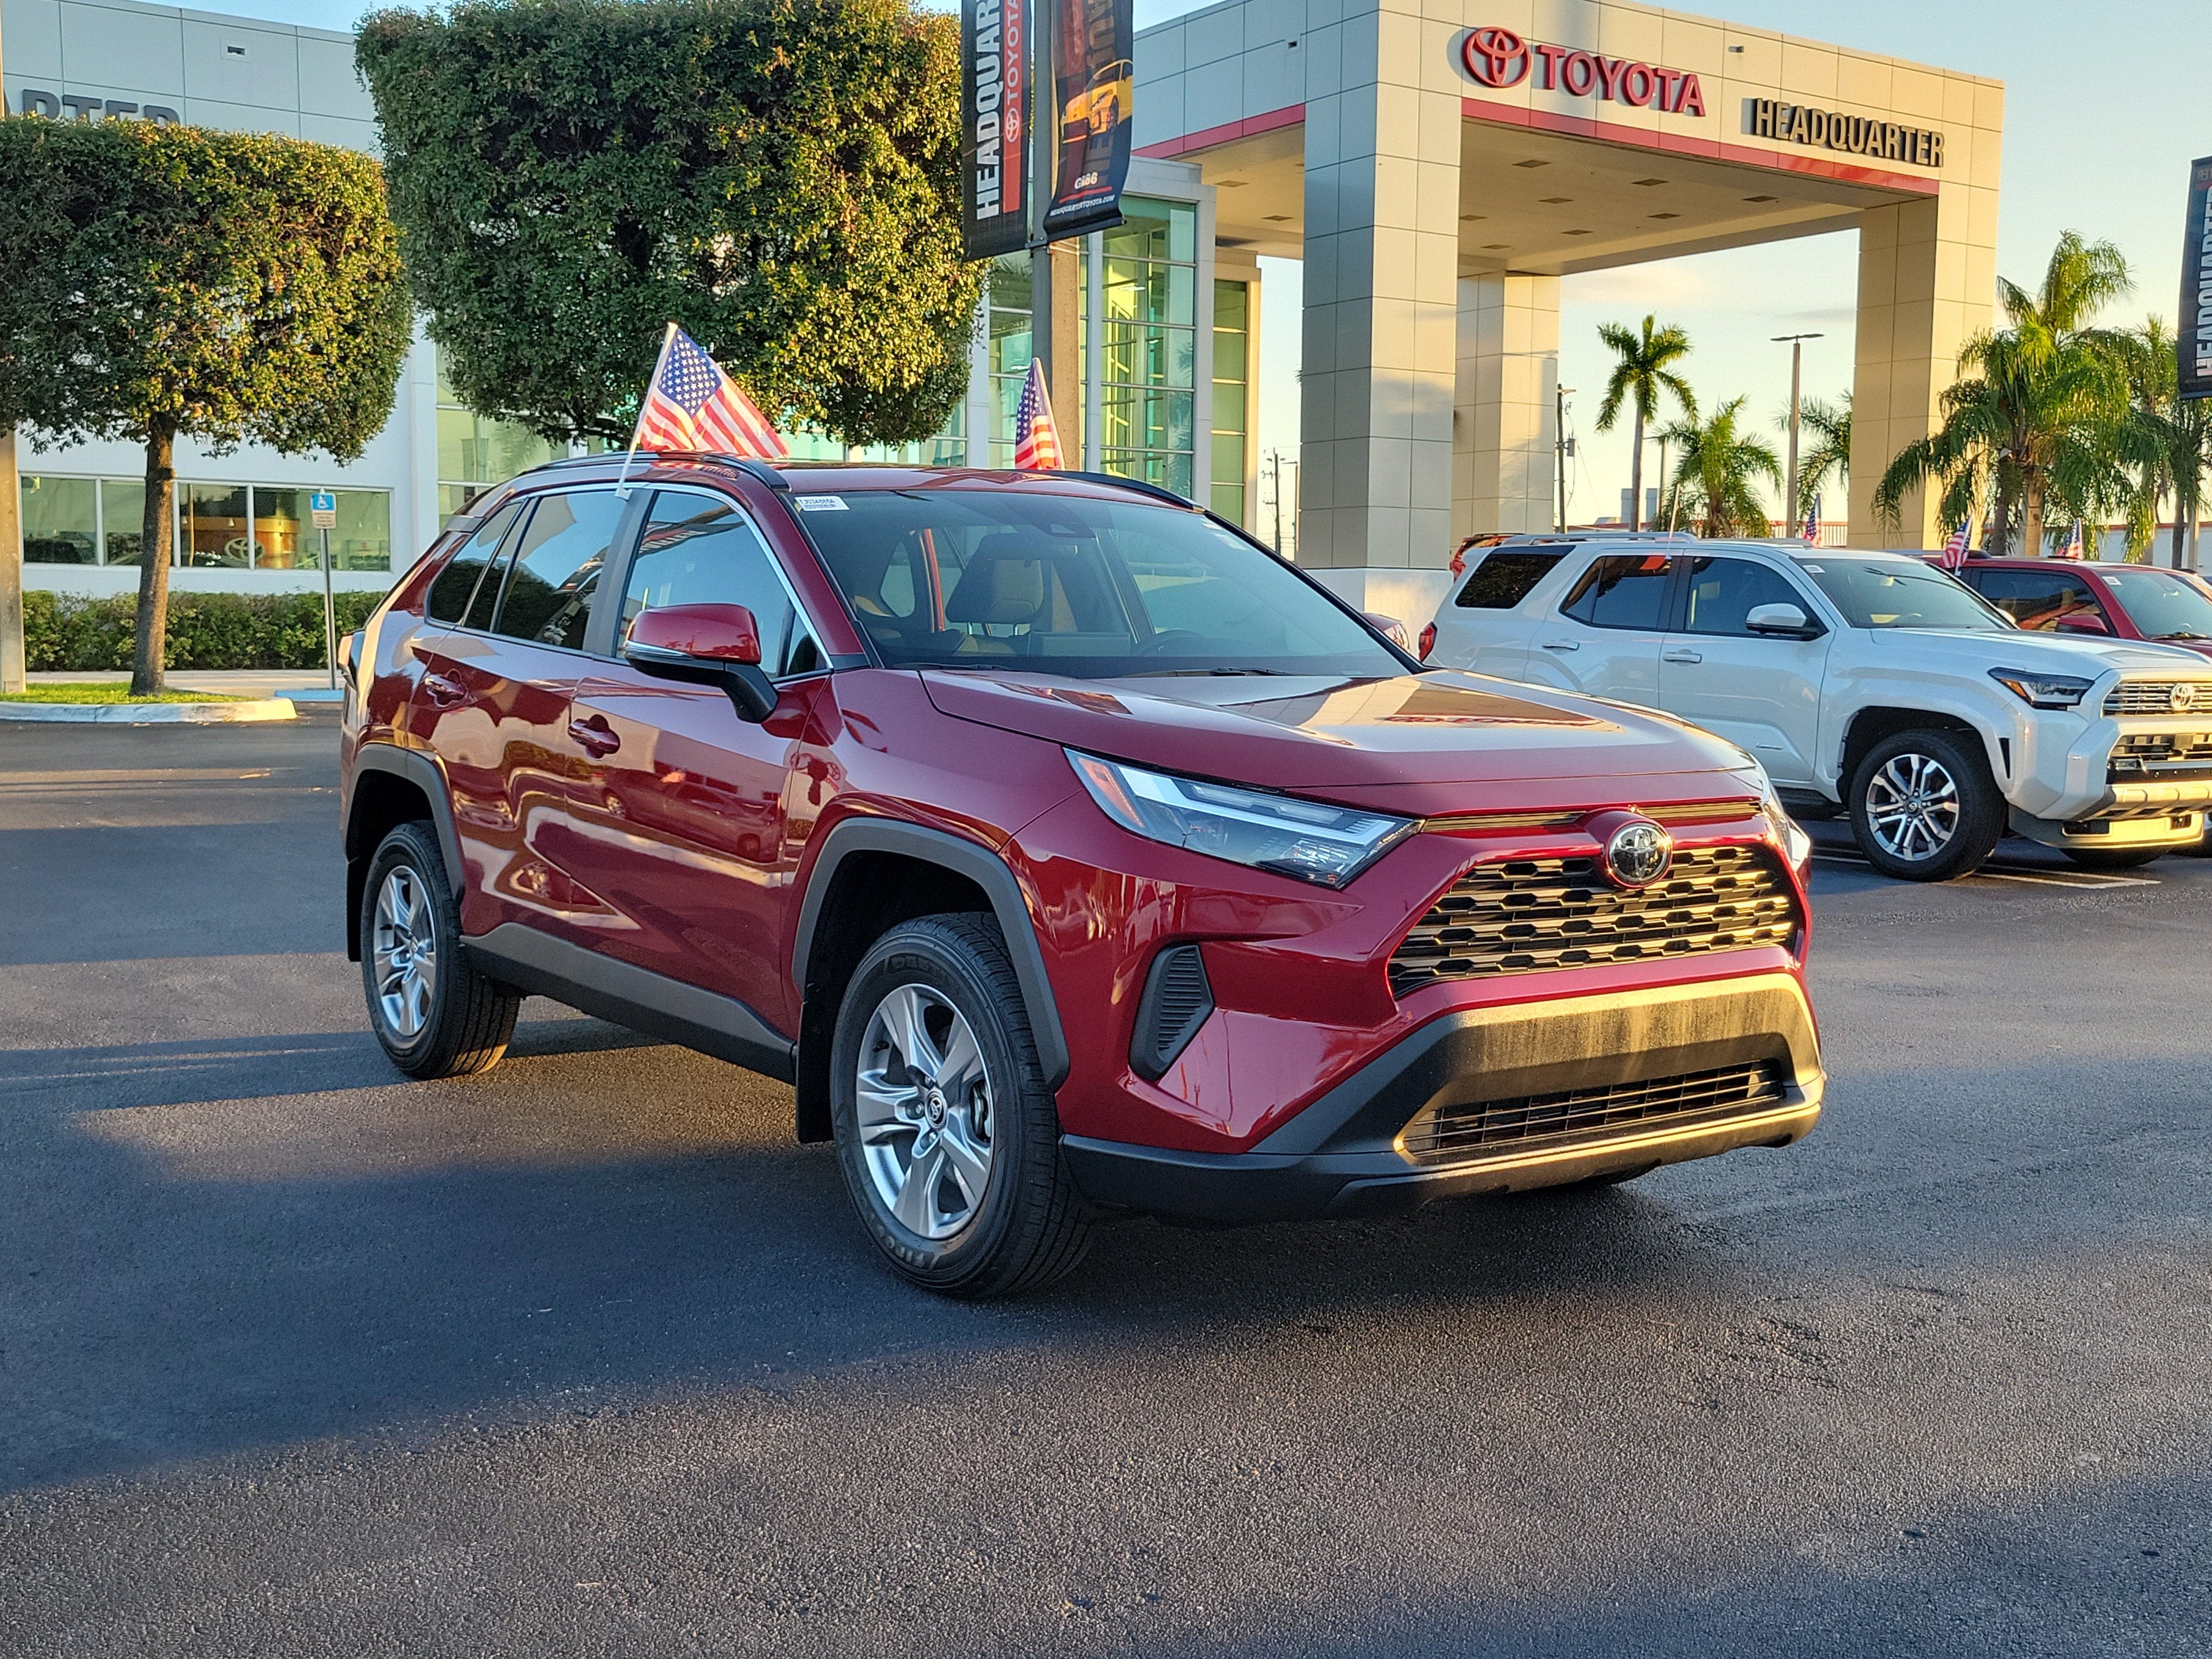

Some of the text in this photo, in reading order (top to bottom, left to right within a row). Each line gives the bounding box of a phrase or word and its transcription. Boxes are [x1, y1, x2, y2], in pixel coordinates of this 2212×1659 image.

[977, 0, 1003, 220] HEADQUAR
[1537, 44, 1706, 117] TOYOTA
[1754, 98, 1945, 167] HEADQUARTER
